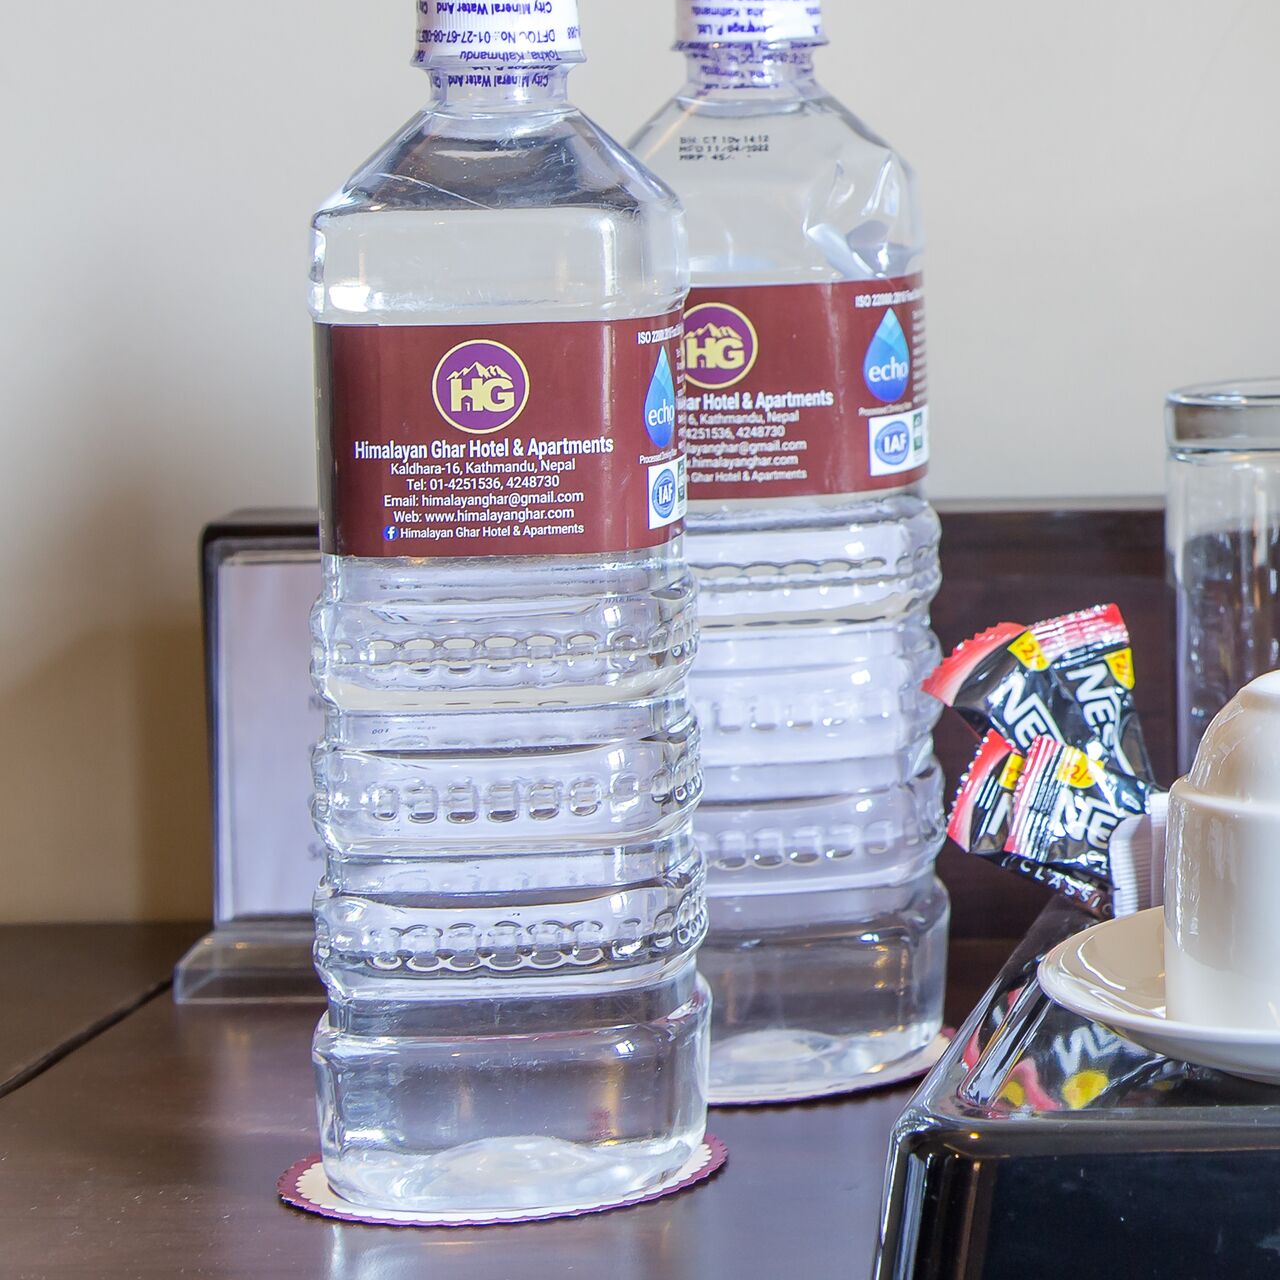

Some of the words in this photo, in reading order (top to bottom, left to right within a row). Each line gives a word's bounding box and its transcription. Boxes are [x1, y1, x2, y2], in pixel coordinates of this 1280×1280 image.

[436, 2, 454, 15] And
[456, 3, 488, 15] Water
[491, 3, 531, 15] Mineral
[534, 0, 552, 14] City
[459, 51, 525, 62] Kathmandu
[637, 331, 651, 345] ISO
[686, 337, 745, 370] HG
[450, 377, 515, 413] HG
[702, 392, 740, 410] Hotel
[742, 392, 753, 409] &
[755, 390, 834, 412] Apartments
[766, 410, 800, 424] Nepal
[686, 426, 735, 440] 4251536,
[736, 425, 785, 439] 4248730
[354, 440, 428, 463] Himalayan
[430, 440, 466, 458] Ghar
[469, 438, 509, 458] Hotel
[512, 438, 524, 457] &
[527, 436, 614, 460] Apartments
[686, 439, 807, 455] layanghar@gmail.com
[884, 432, 907, 454] IAF
[390, 462, 463, 477] Kaldhara-16,
[465, 460, 538, 475] Kathmandu,
[540, 458, 576, 474] Nepal
[752, 468, 808, 483] Apartments
[406, 479, 427, 491] Tel:
[429, 477, 504, 492] 01-4251536,
[505, 475, 560, 488] 4248730
[384, 494, 419, 508] Email:
[421, 491, 584, 509] himalayanghar@gmail.com
[658, 484, 674, 505] IAF
[393, 510, 423, 523] Web:
[424, 507, 575, 524] www.himalayanghar.com
[400, 528, 454, 541] Himalayan
[455, 527, 480, 538] Ghar
[483, 526, 511, 538] Hotel
[512, 526, 521, 536] &
[522, 524, 584, 538] Apartments
